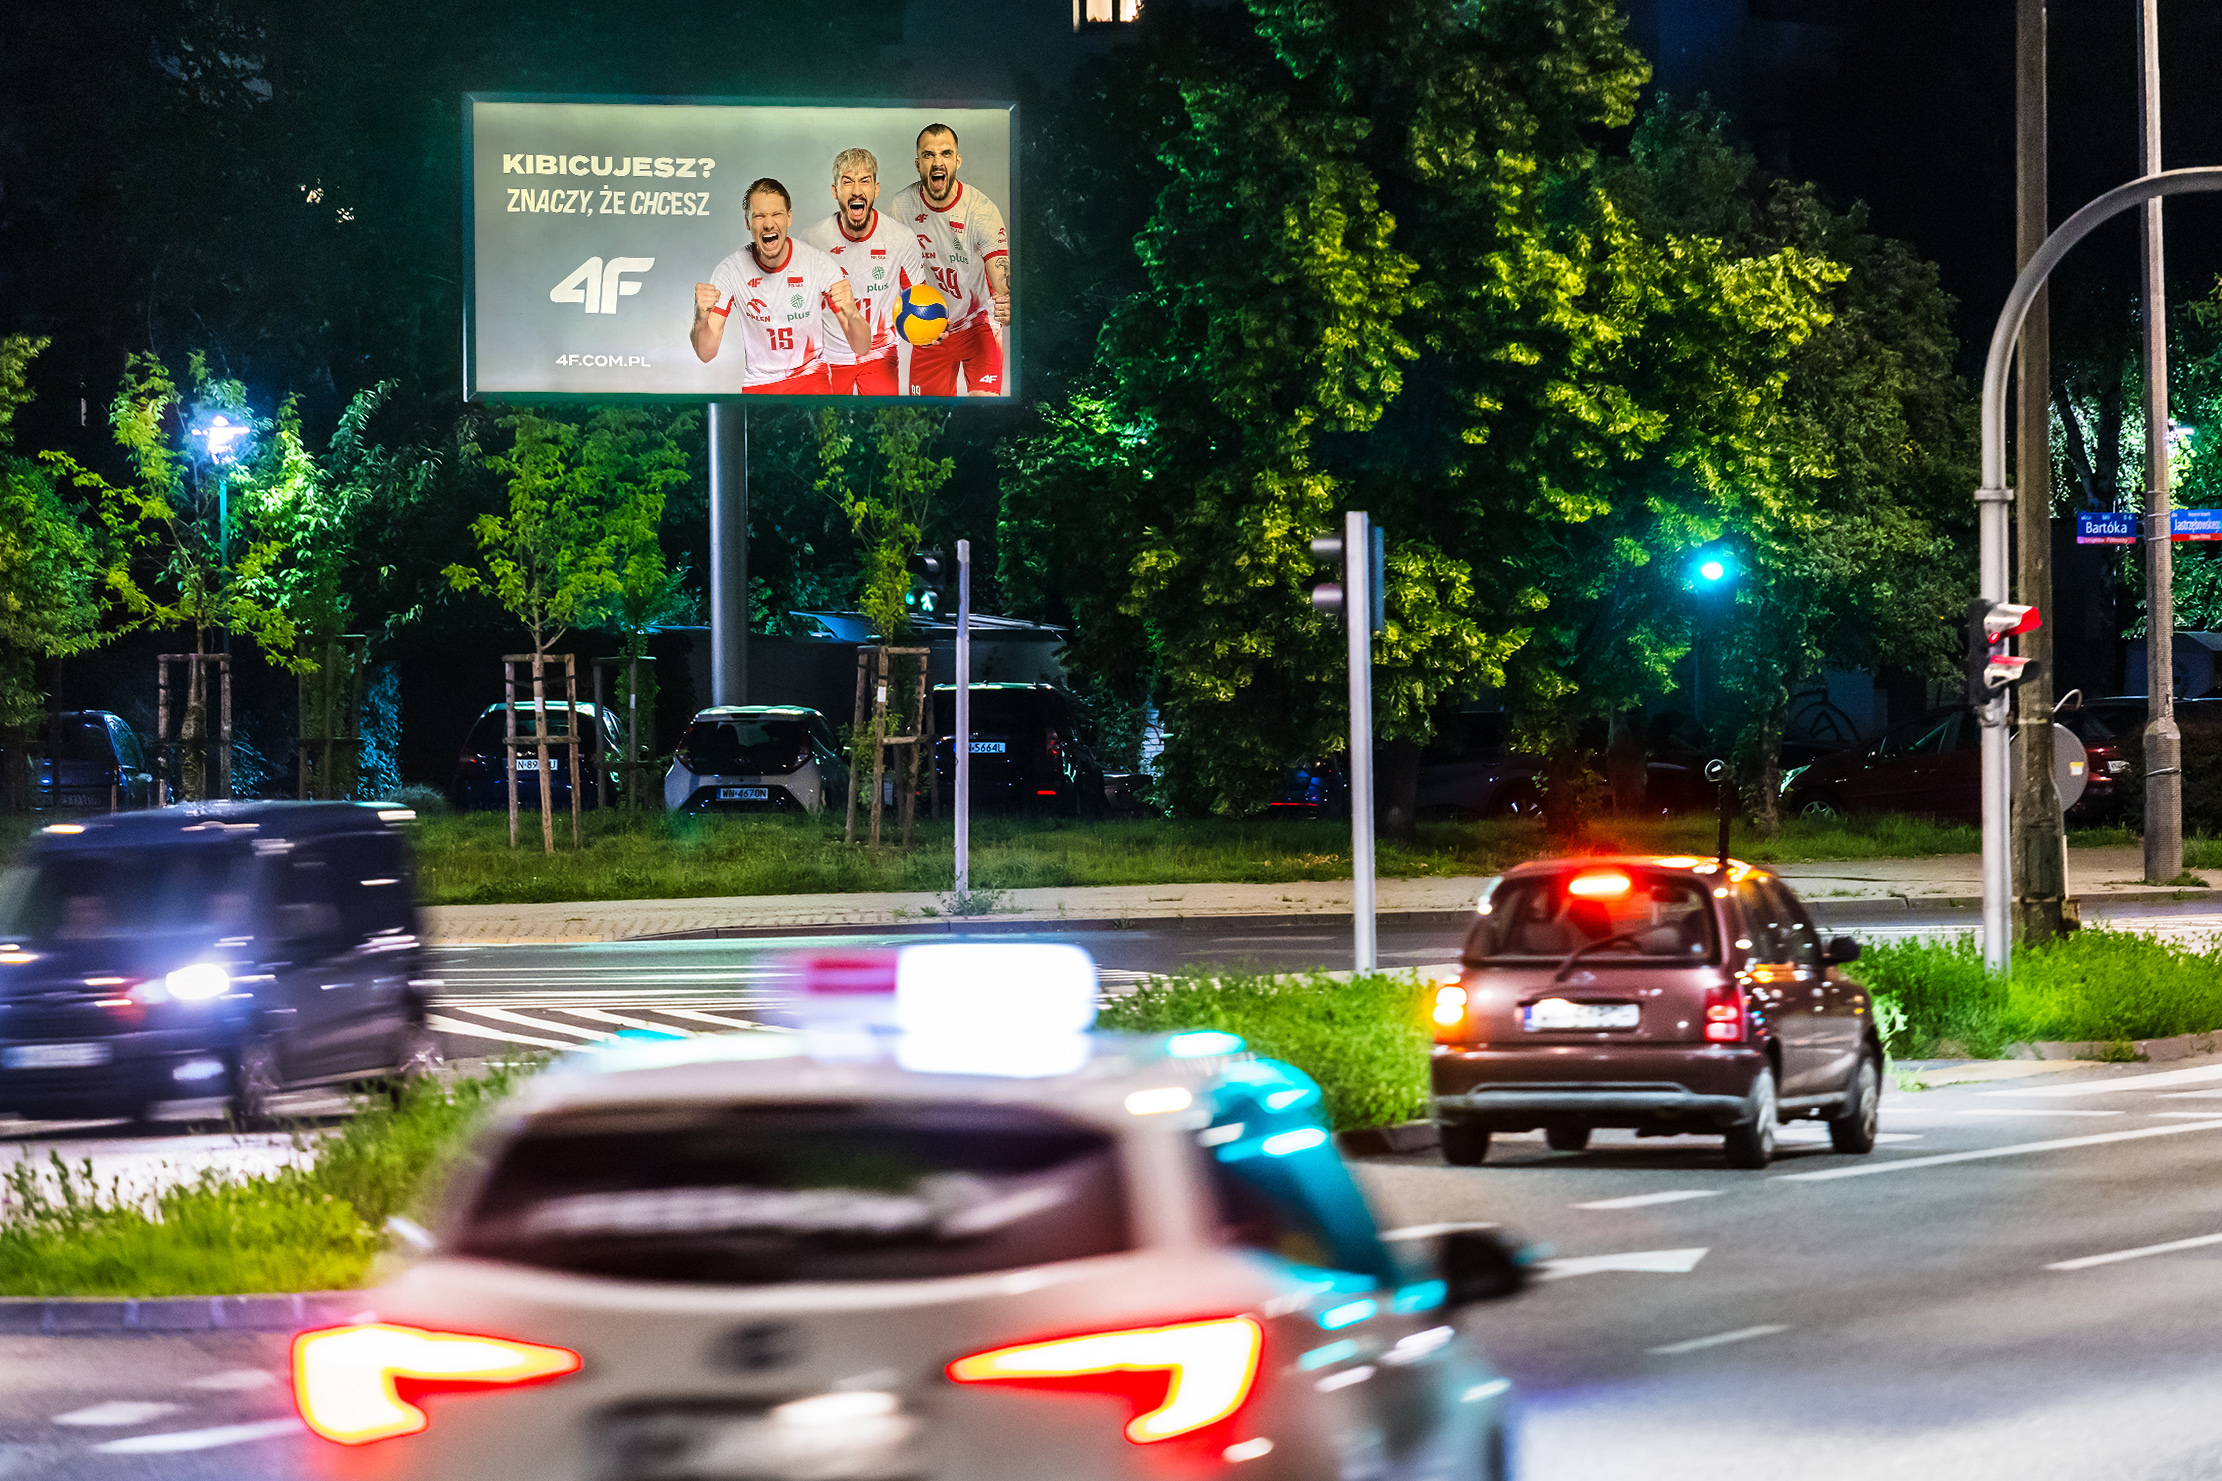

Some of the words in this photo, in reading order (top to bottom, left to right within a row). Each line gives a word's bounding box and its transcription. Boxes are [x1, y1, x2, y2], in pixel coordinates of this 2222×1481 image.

[503, 154, 716, 178] KIBICUJESZ?
[507, 188, 594, 217] ZNACZY,
[599, 184, 626, 215] ŻE
[630, 191, 710, 216] CHCESZ
[949, 253, 969, 265] plus
[550, 256, 655, 314] 4F
[747, 277, 763, 288] 4F
[867, 282, 889, 293] plus
[787, 311, 811, 322] plus
[766, 327, 794, 351] 15
[555, 354, 651, 367] 4F.COM.PL
[979, 374, 998, 384] 4F
[2085, 520, 2128, 534] Bartóka
